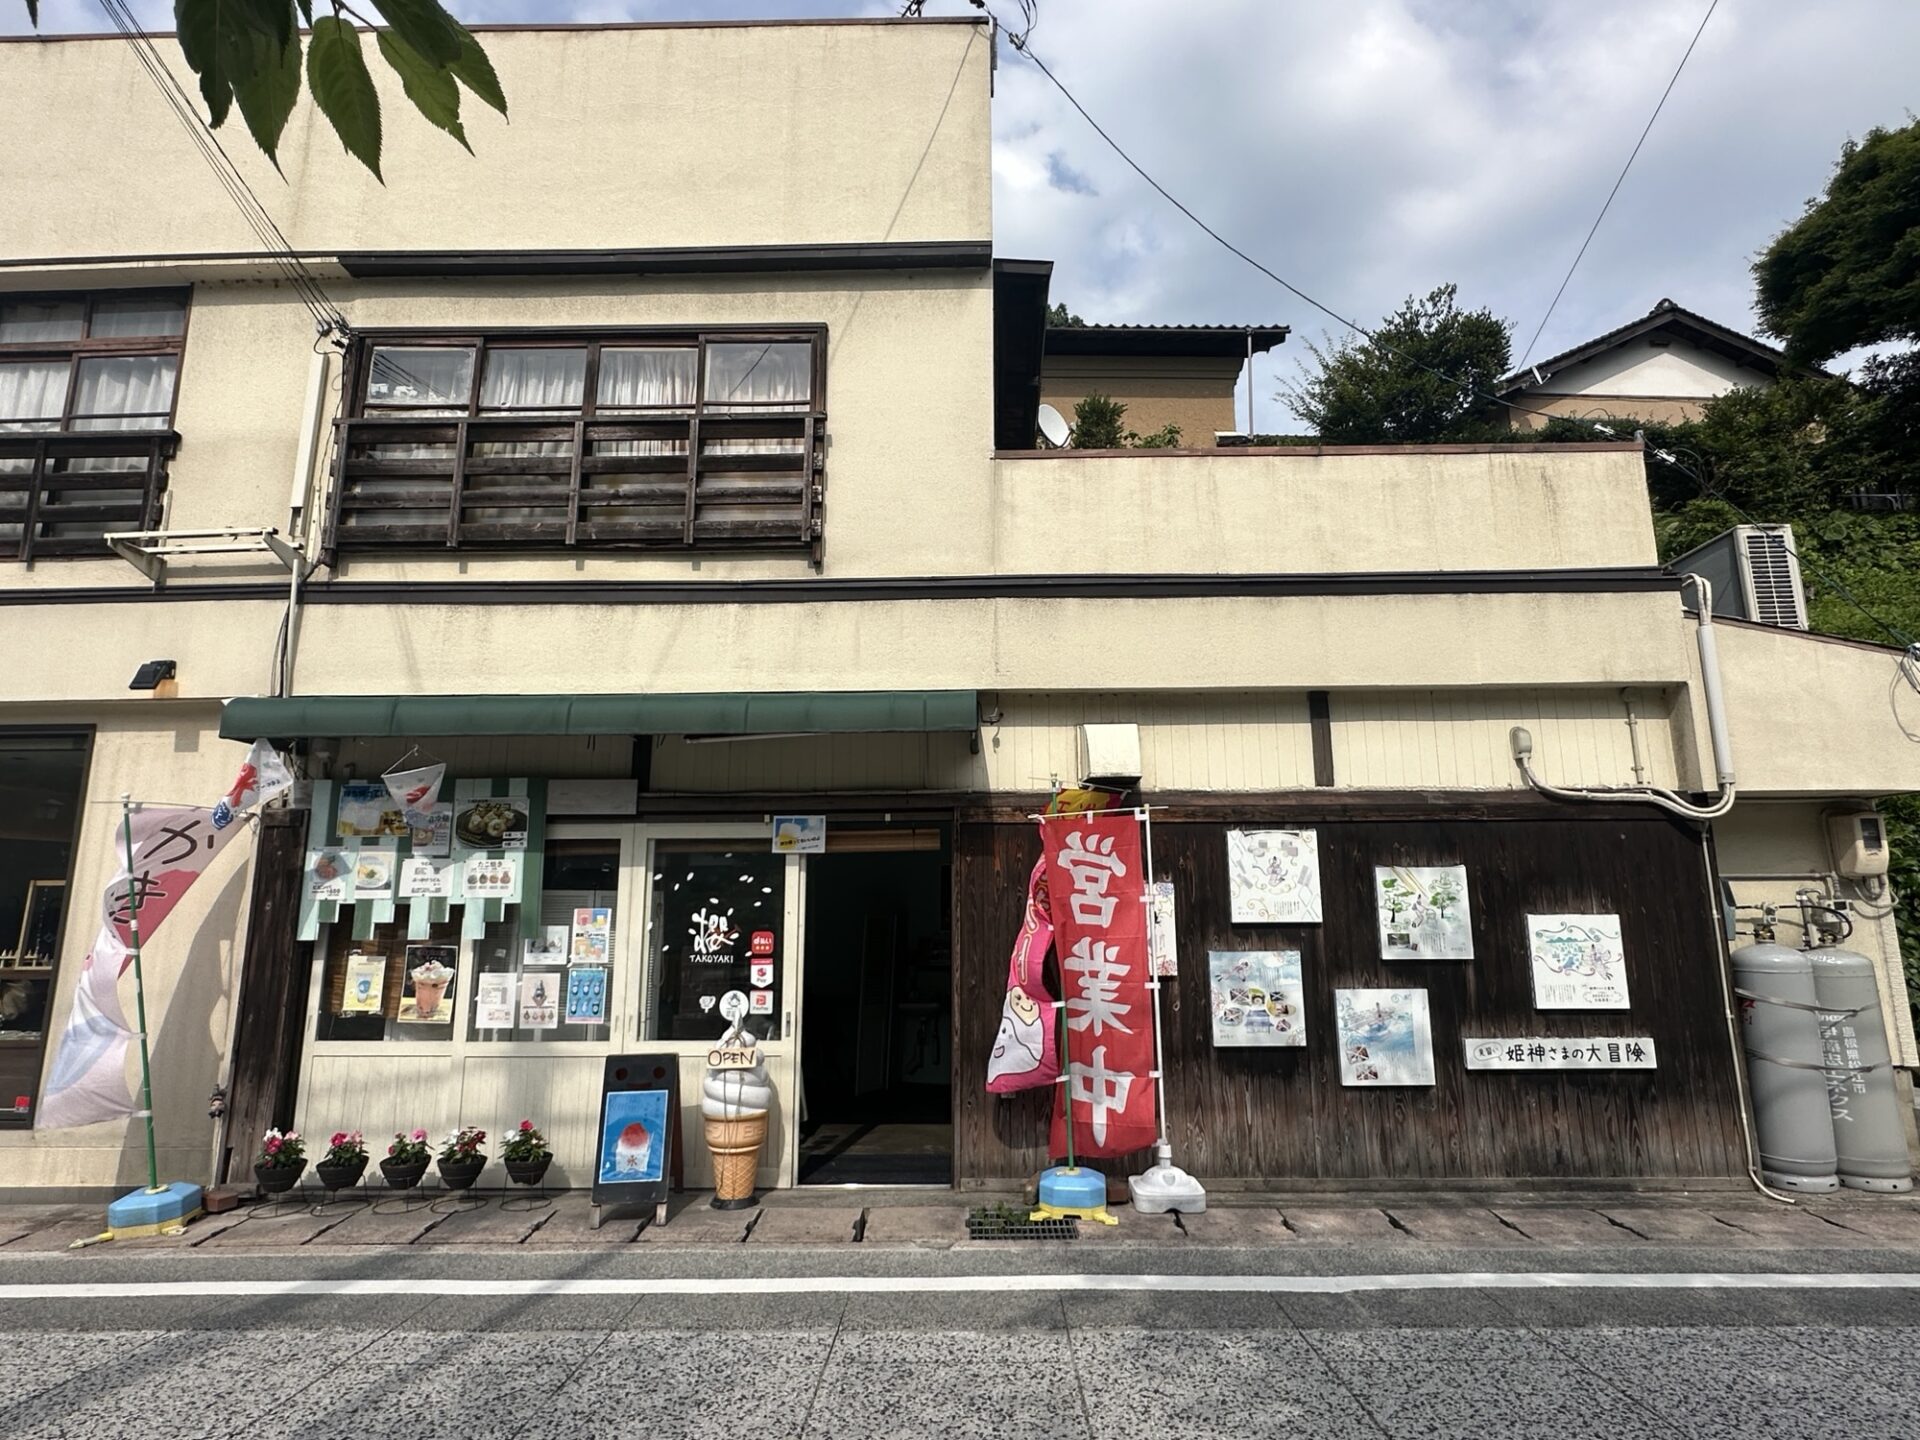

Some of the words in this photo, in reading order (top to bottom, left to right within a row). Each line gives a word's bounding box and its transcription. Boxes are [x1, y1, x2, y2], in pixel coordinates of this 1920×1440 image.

[689, 954, 734, 964] TAKOYAKI
[1056, 830, 1135, 1149] 営業中
[708, 1050, 756, 1067] OPEN
[1505, 1042, 1646, 1063] 姫神さまの大冒険
